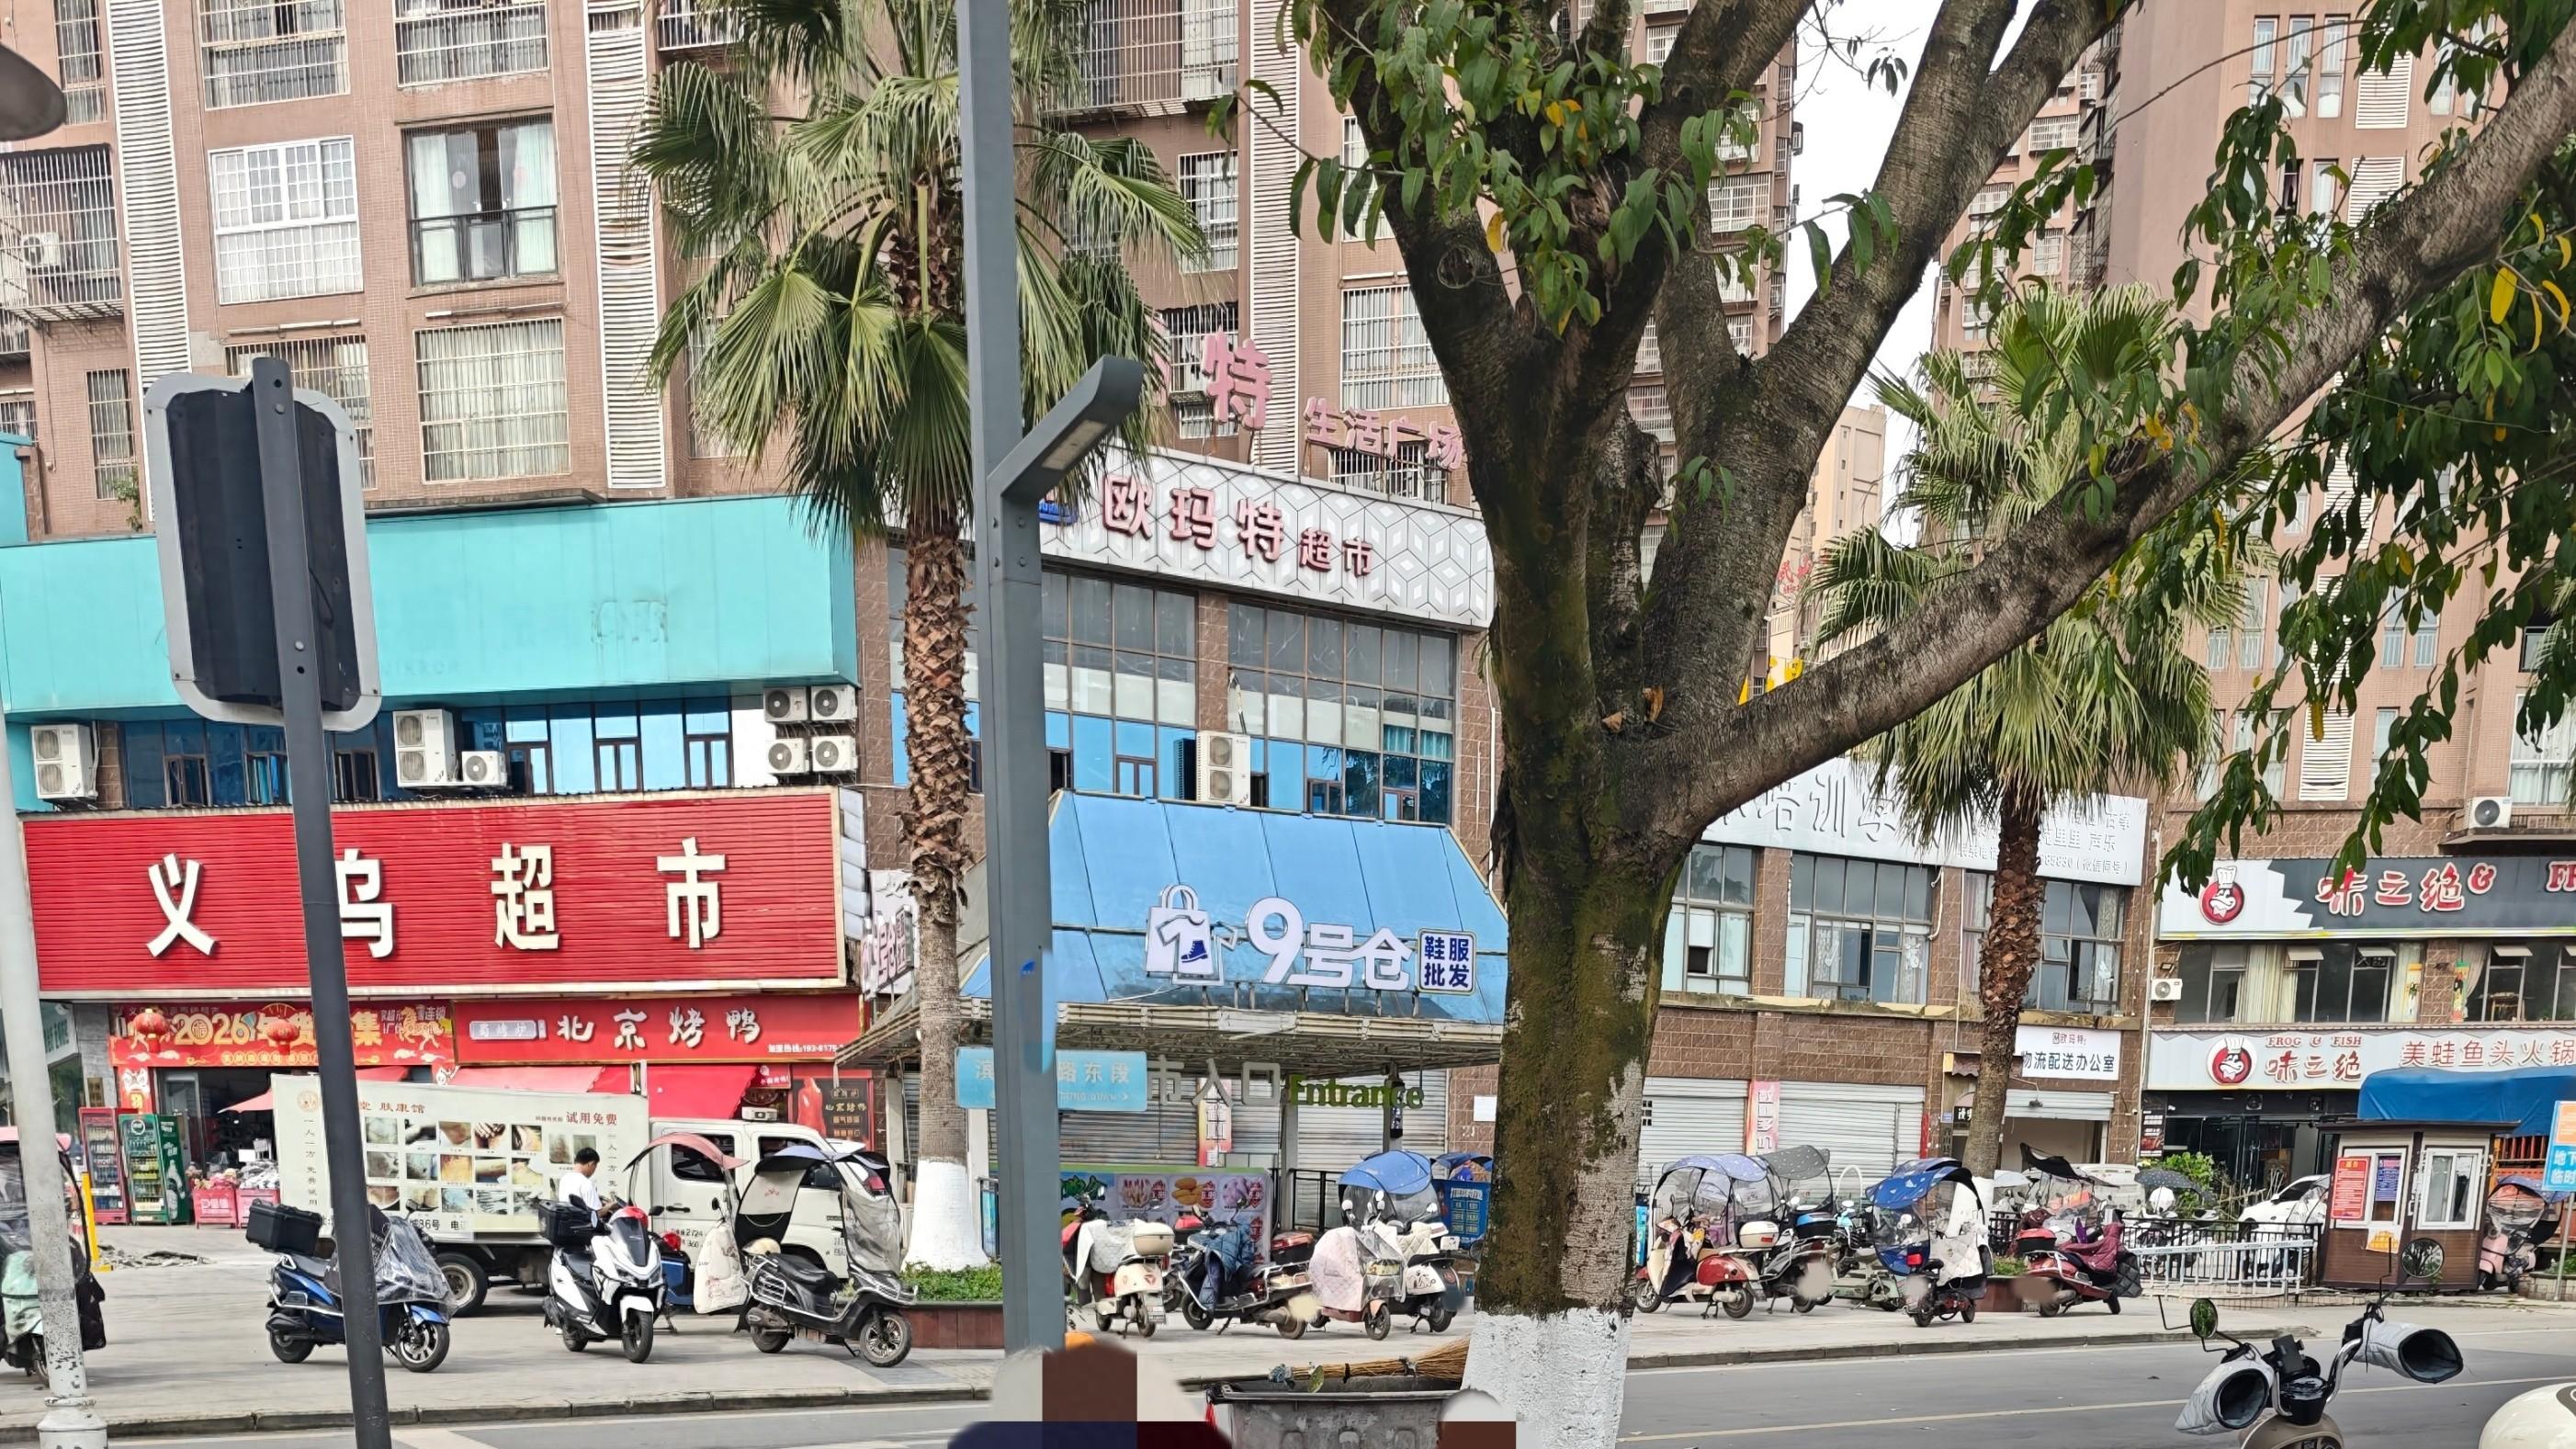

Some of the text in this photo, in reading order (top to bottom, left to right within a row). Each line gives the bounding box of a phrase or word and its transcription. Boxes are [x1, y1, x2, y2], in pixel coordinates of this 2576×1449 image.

[1303, 396, 1464, 471] 生活广场
[1102, 472, 1375, 579] 欧玛特超市
[146, 836, 727, 960] 义乌超市
[2314, 861, 2466, 917] 味之绝
[1246, 897, 1413, 991] 9号仓
[1424, 935, 1469, 962] 鞋服
[1424, 963, 1470, 988] 批发
[557, 1008, 762, 1050] 北京烤鸭
[2266, 1036, 2300, 1047] FROG
[2332, 1036, 2363, 1047] FISH
[2021, 1051, 2115, 1073] 物流配送办公室
[2264, 1050, 2363, 1082] 味之绝
[2401, 1038, 2576, 1068] 美蛙鱼头火锅
[976, 1059, 1130, 1084] 滨路东段
[1290, 1072, 1425, 1110] Entrance
[566, 1111, 617, 1126] 试用免费
